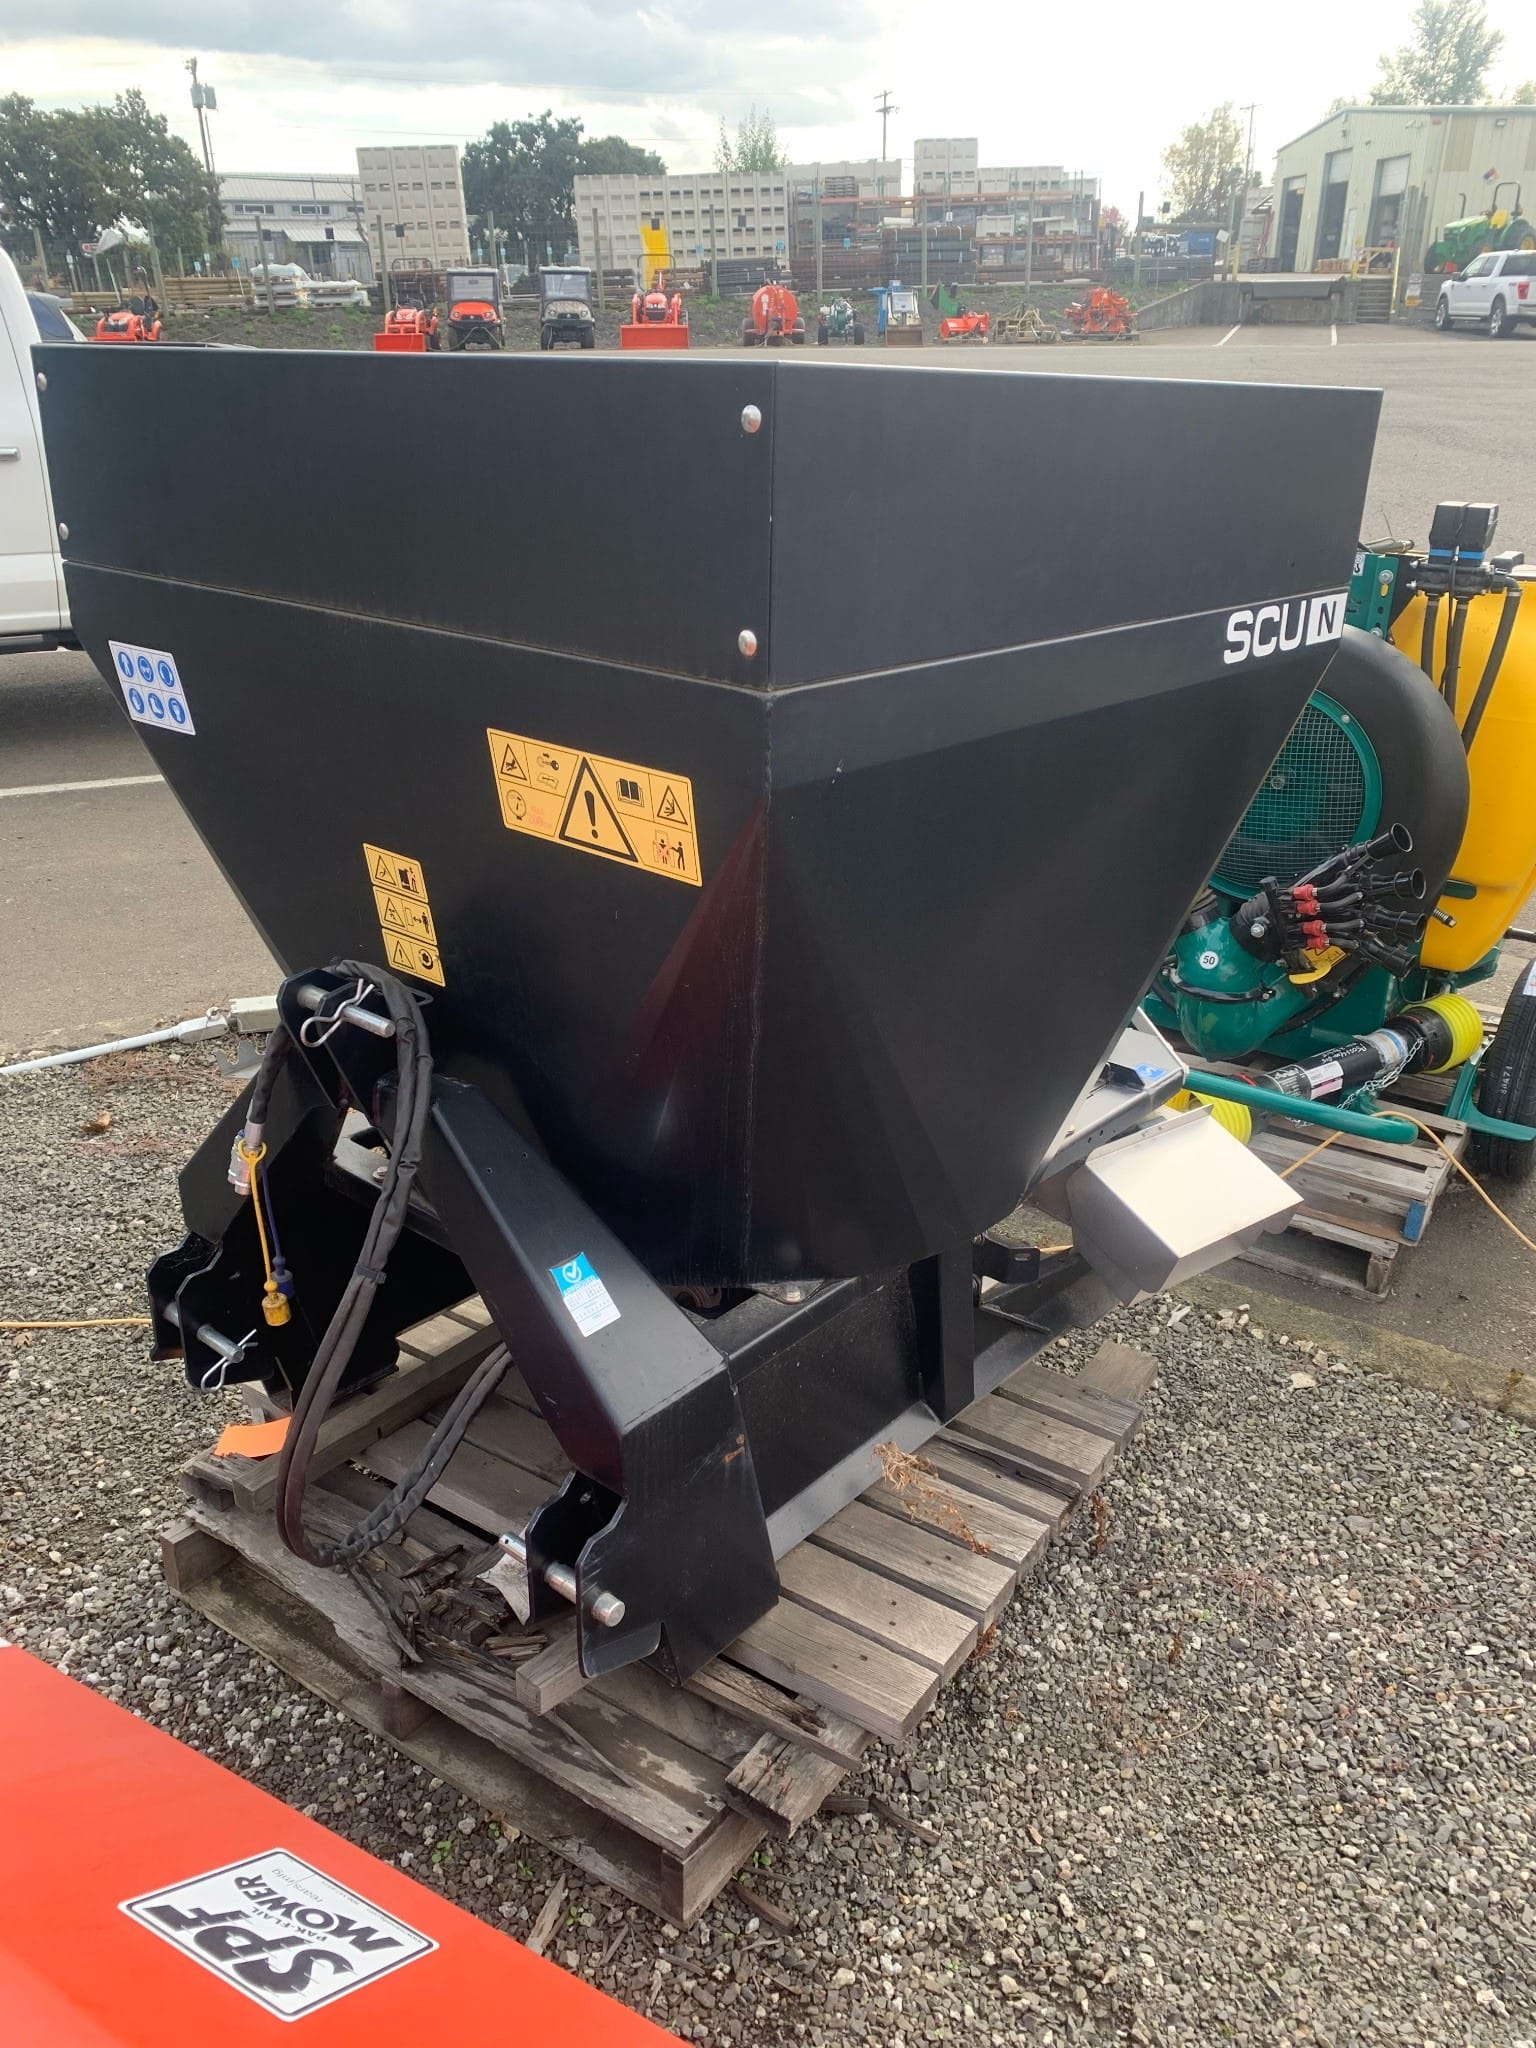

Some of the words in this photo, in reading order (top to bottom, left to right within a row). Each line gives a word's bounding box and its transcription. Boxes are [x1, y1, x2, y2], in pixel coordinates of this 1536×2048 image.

[1202, 955, 1216, 965] 50
[234, 1874, 404, 1953] MOWER
[252, 1906, 328, 1942] PAK-FLAIL
[142, 1904, 355, 1994] SPF
